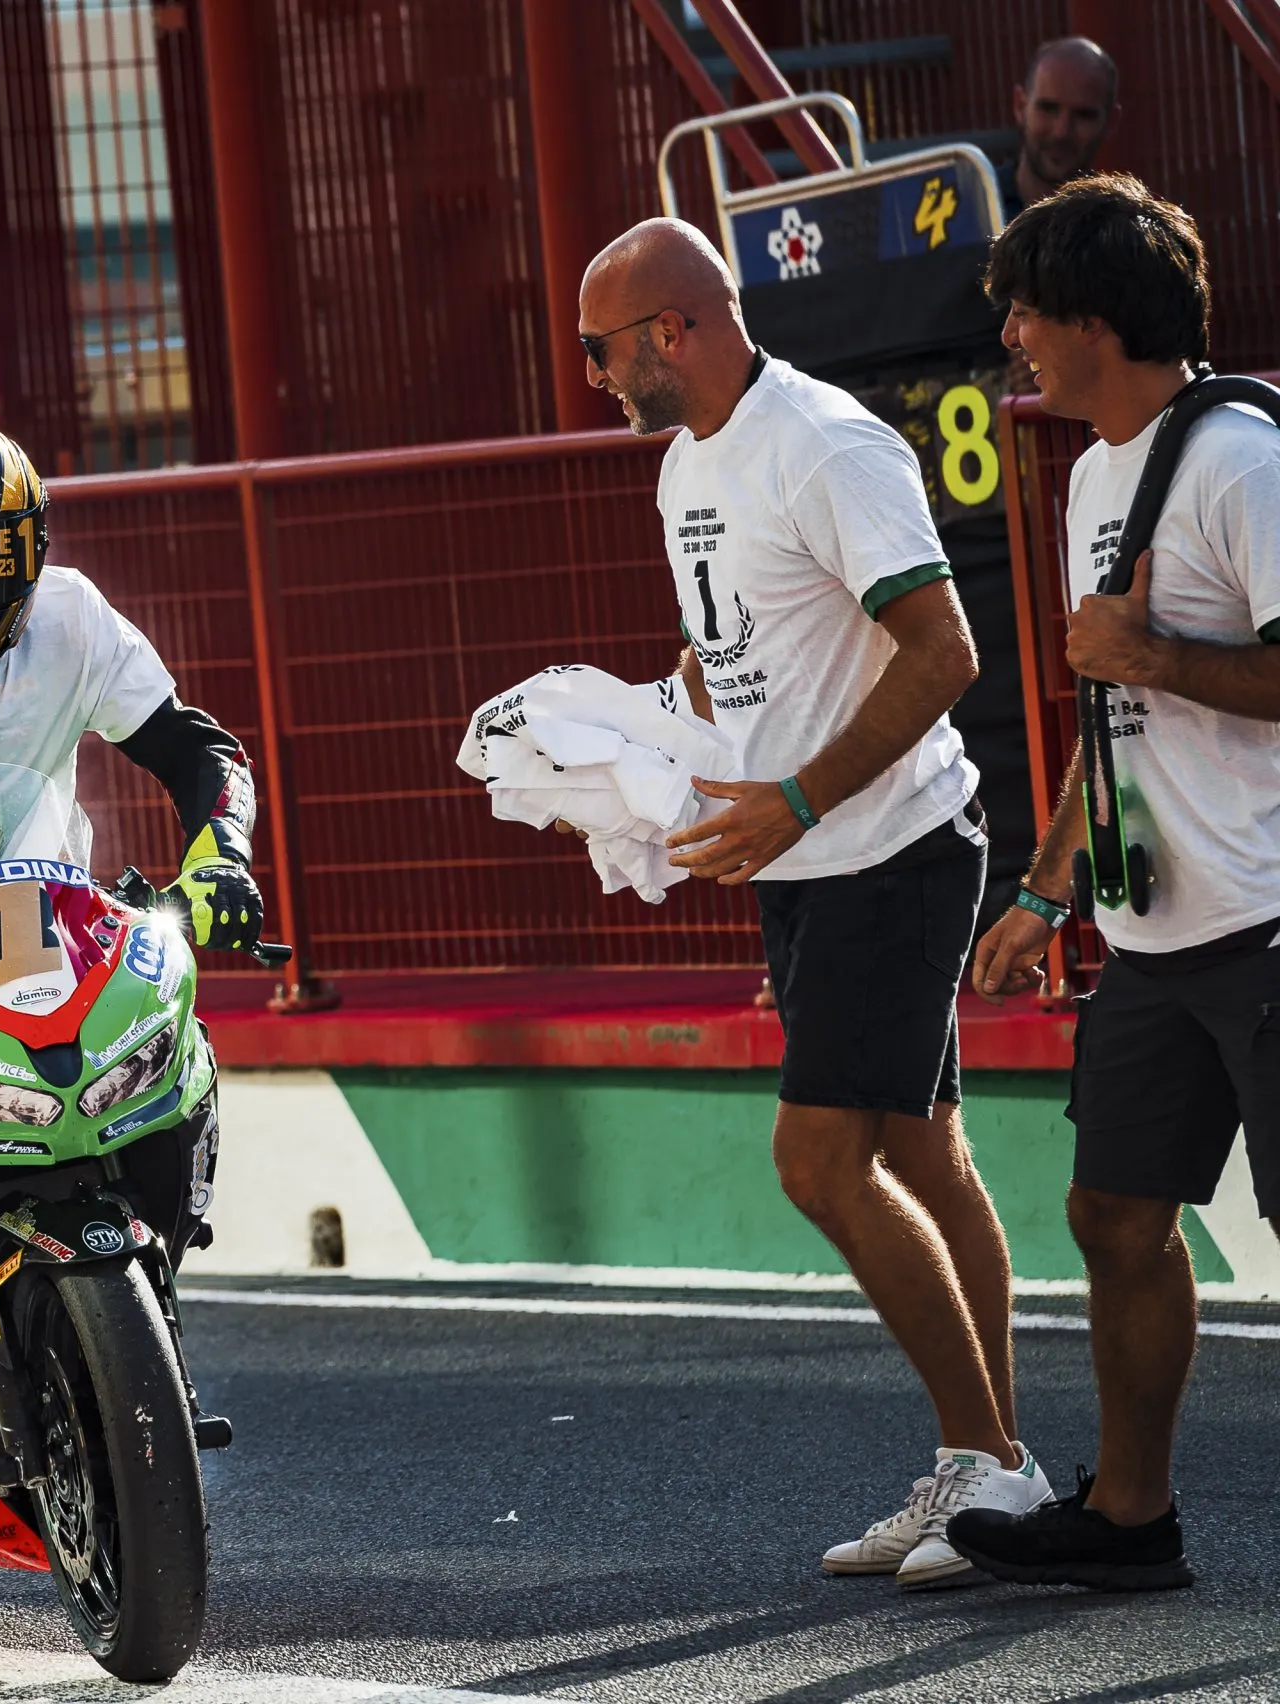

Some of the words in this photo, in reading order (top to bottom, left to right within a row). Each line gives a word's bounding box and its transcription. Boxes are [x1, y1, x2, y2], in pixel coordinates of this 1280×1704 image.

[938, 385, 999, 506] 8
[16, 518, 36, 581] 1
[679, 525, 701, 538] CAMPIONE
[701, 523, 725, 536] ITALIANO
[694, 560, 723, 642] 1
[16, 987, 59, 1003] domino
[86, 1228, 120, 1246] STM
